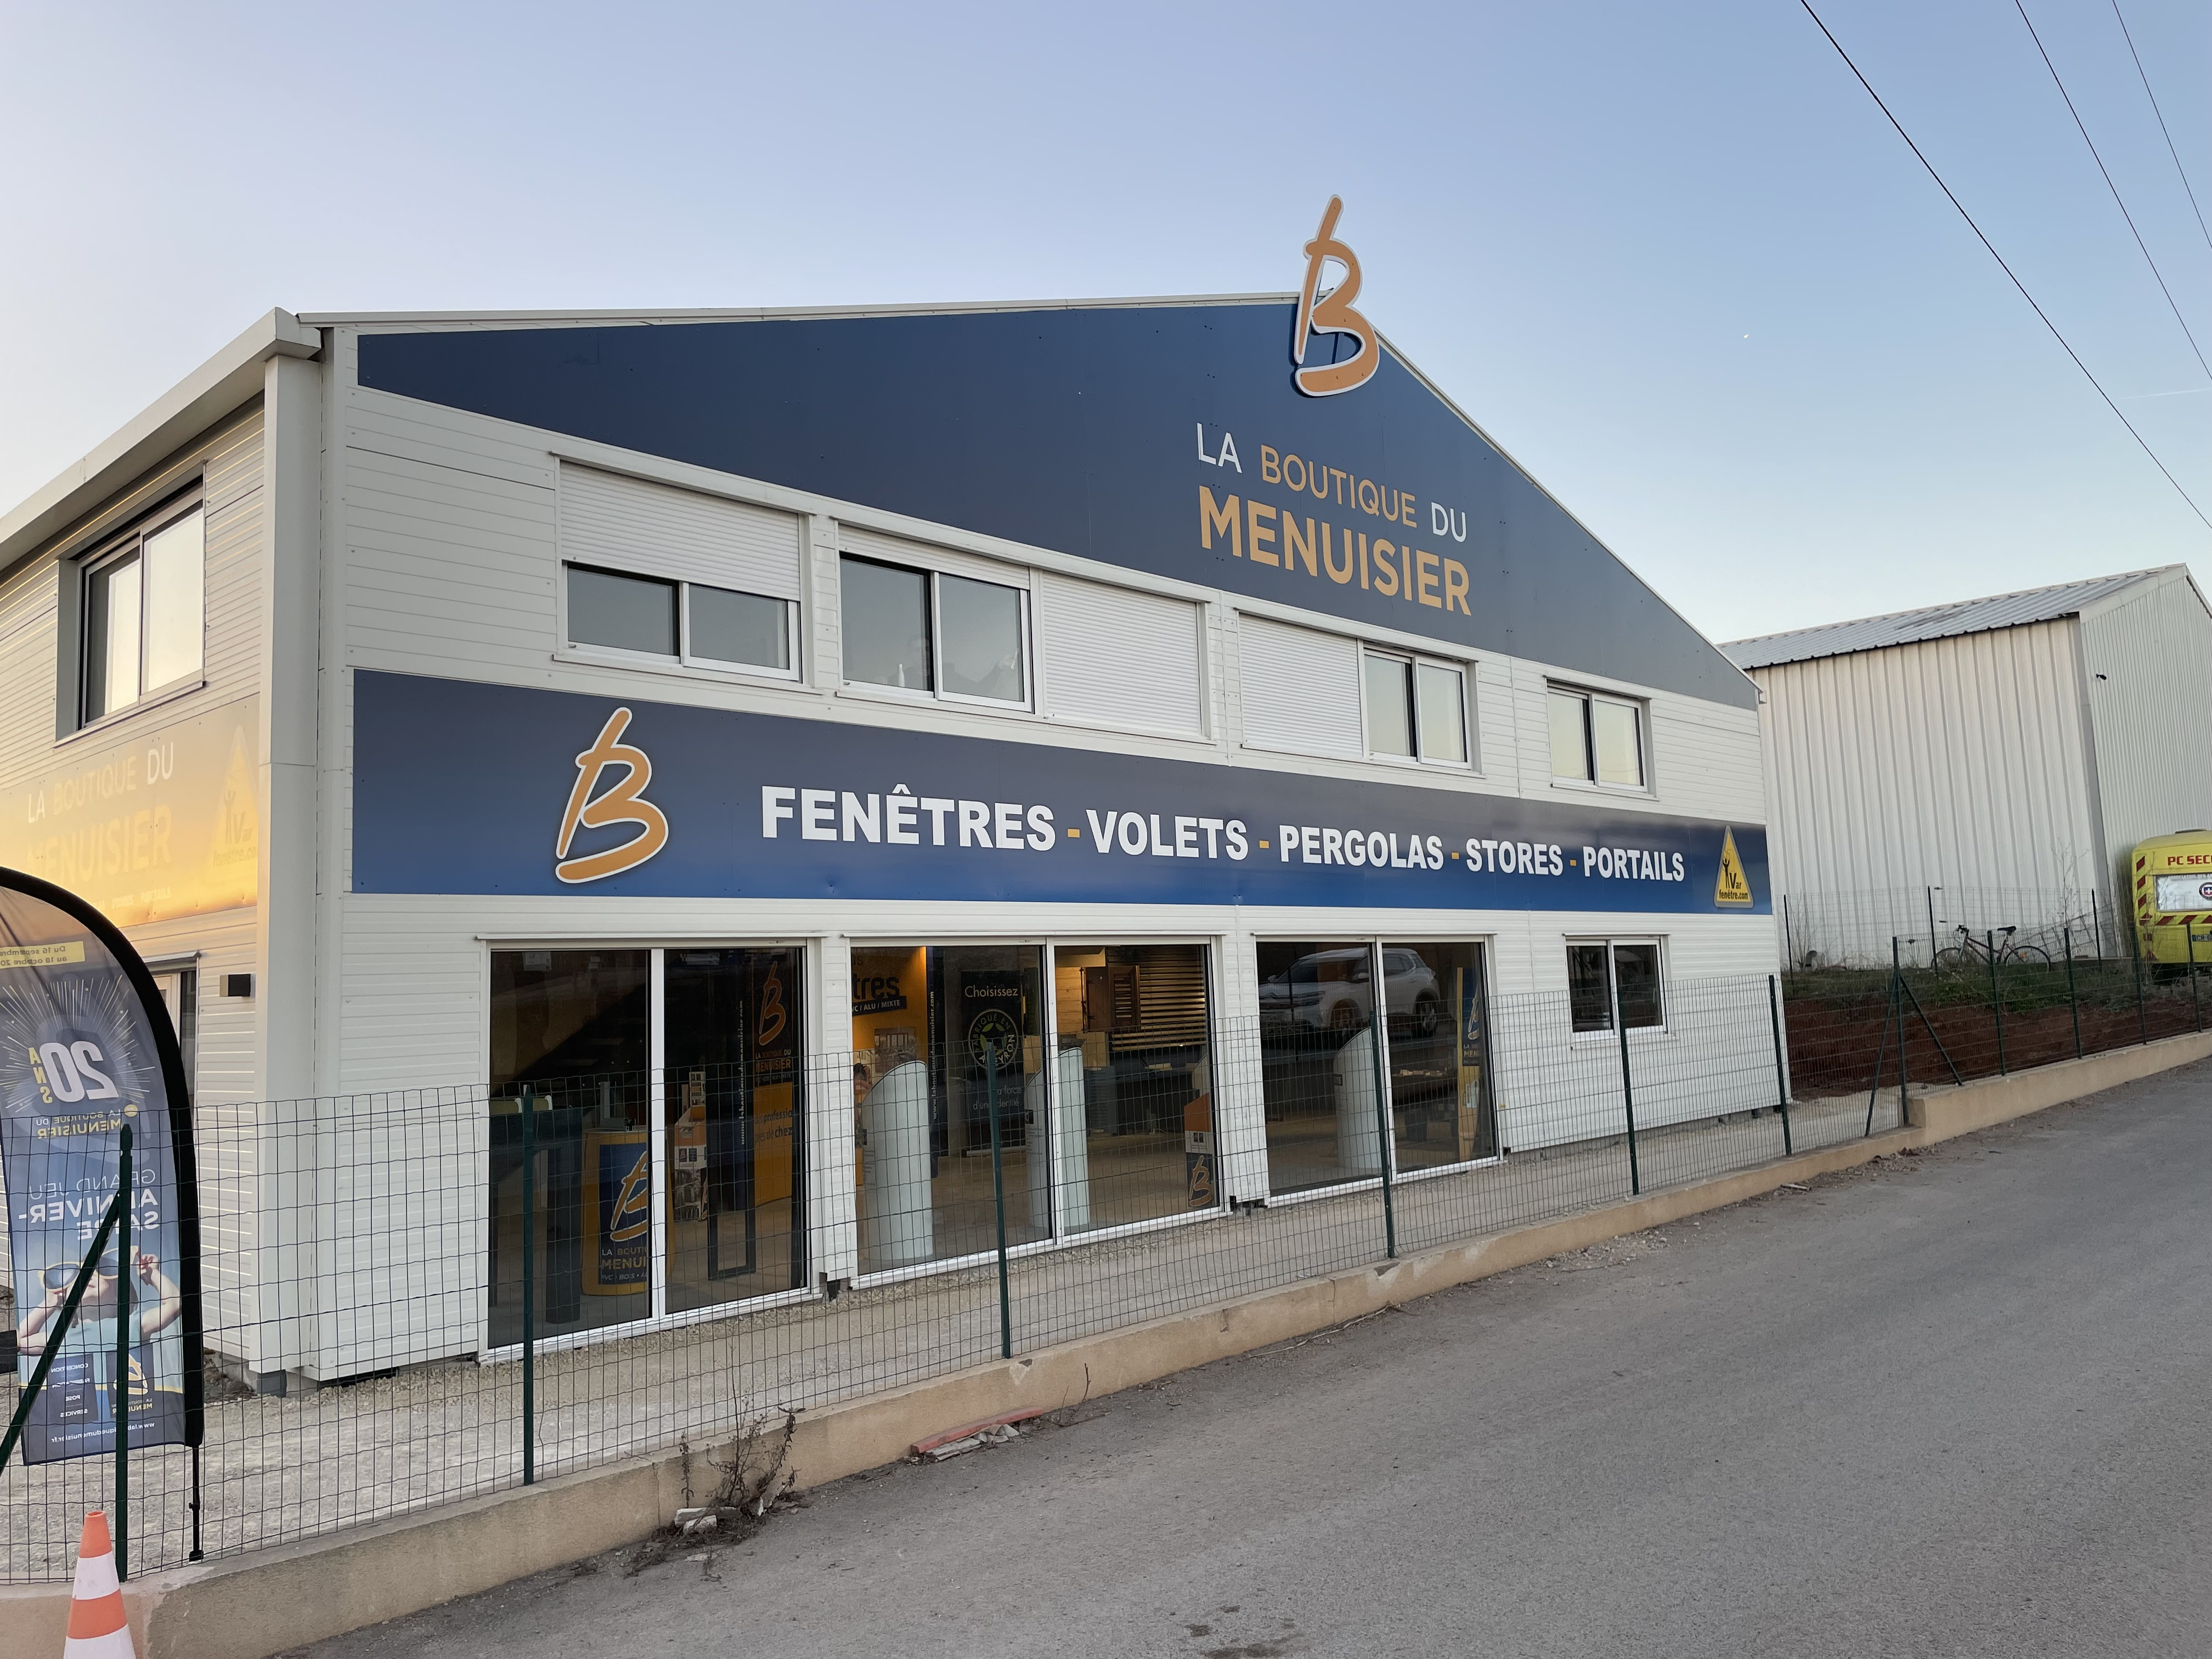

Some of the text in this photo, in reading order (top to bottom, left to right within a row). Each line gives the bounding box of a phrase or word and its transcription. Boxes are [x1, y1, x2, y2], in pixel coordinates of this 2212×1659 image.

[1197, 423, 1466, 542] LA BOUTIQUE DU
[1199, 485, 1471, 616] MENUISIER
[29, 742, 174, 823] LA BOUTIQUE DU
[761, 783, 1056, 851] FENÊTRES
[1086, 809, 1249, 861] VOLETS
[1279, 825, 1444, 870] PERGOLAS
[1466, 838, 1563, 877] STORES
[1583, 845, 1684, 882] PORTAILS
[2168, 856, 2183, 866] PC
[1729, 872, 1742, 889] Var
[964, 984, 1019, 998] Choisissez
[881, 1000, 901, 1008] MIXTE
[1000, 1018, 1011, 1030] EN
